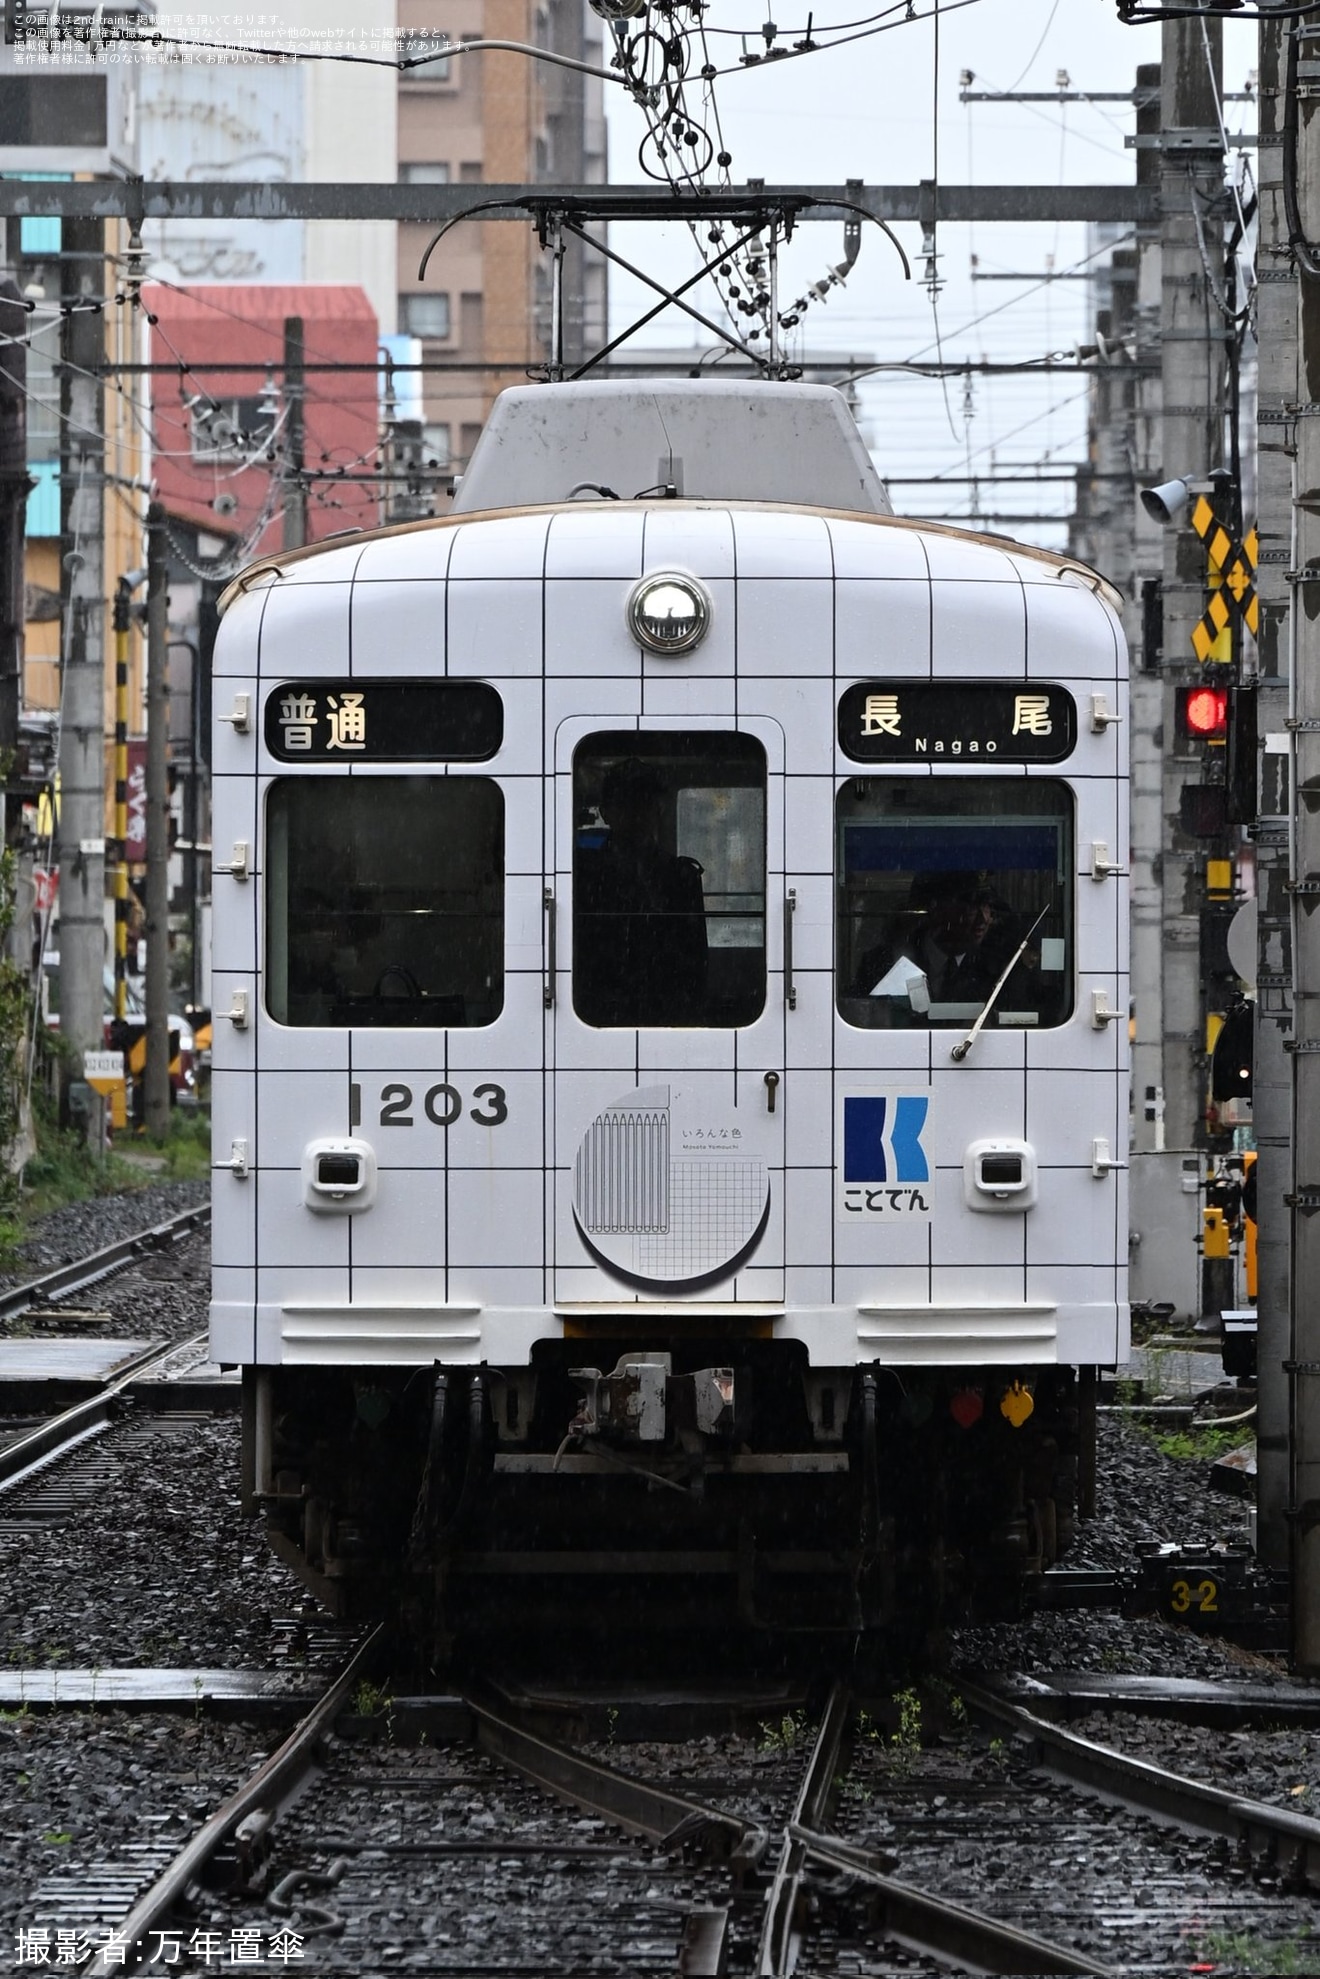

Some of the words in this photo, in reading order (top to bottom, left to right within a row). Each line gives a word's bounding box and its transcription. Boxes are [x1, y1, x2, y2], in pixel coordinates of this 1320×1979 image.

[279, 693, 366, 750] 普通
[915, 738, 997, 754] Nagao
[351, 1083, 508, 1126] 1203
[682, 1128, 742, 1138] いろんな色
[844, 1189, 929, 1212] ことでん
